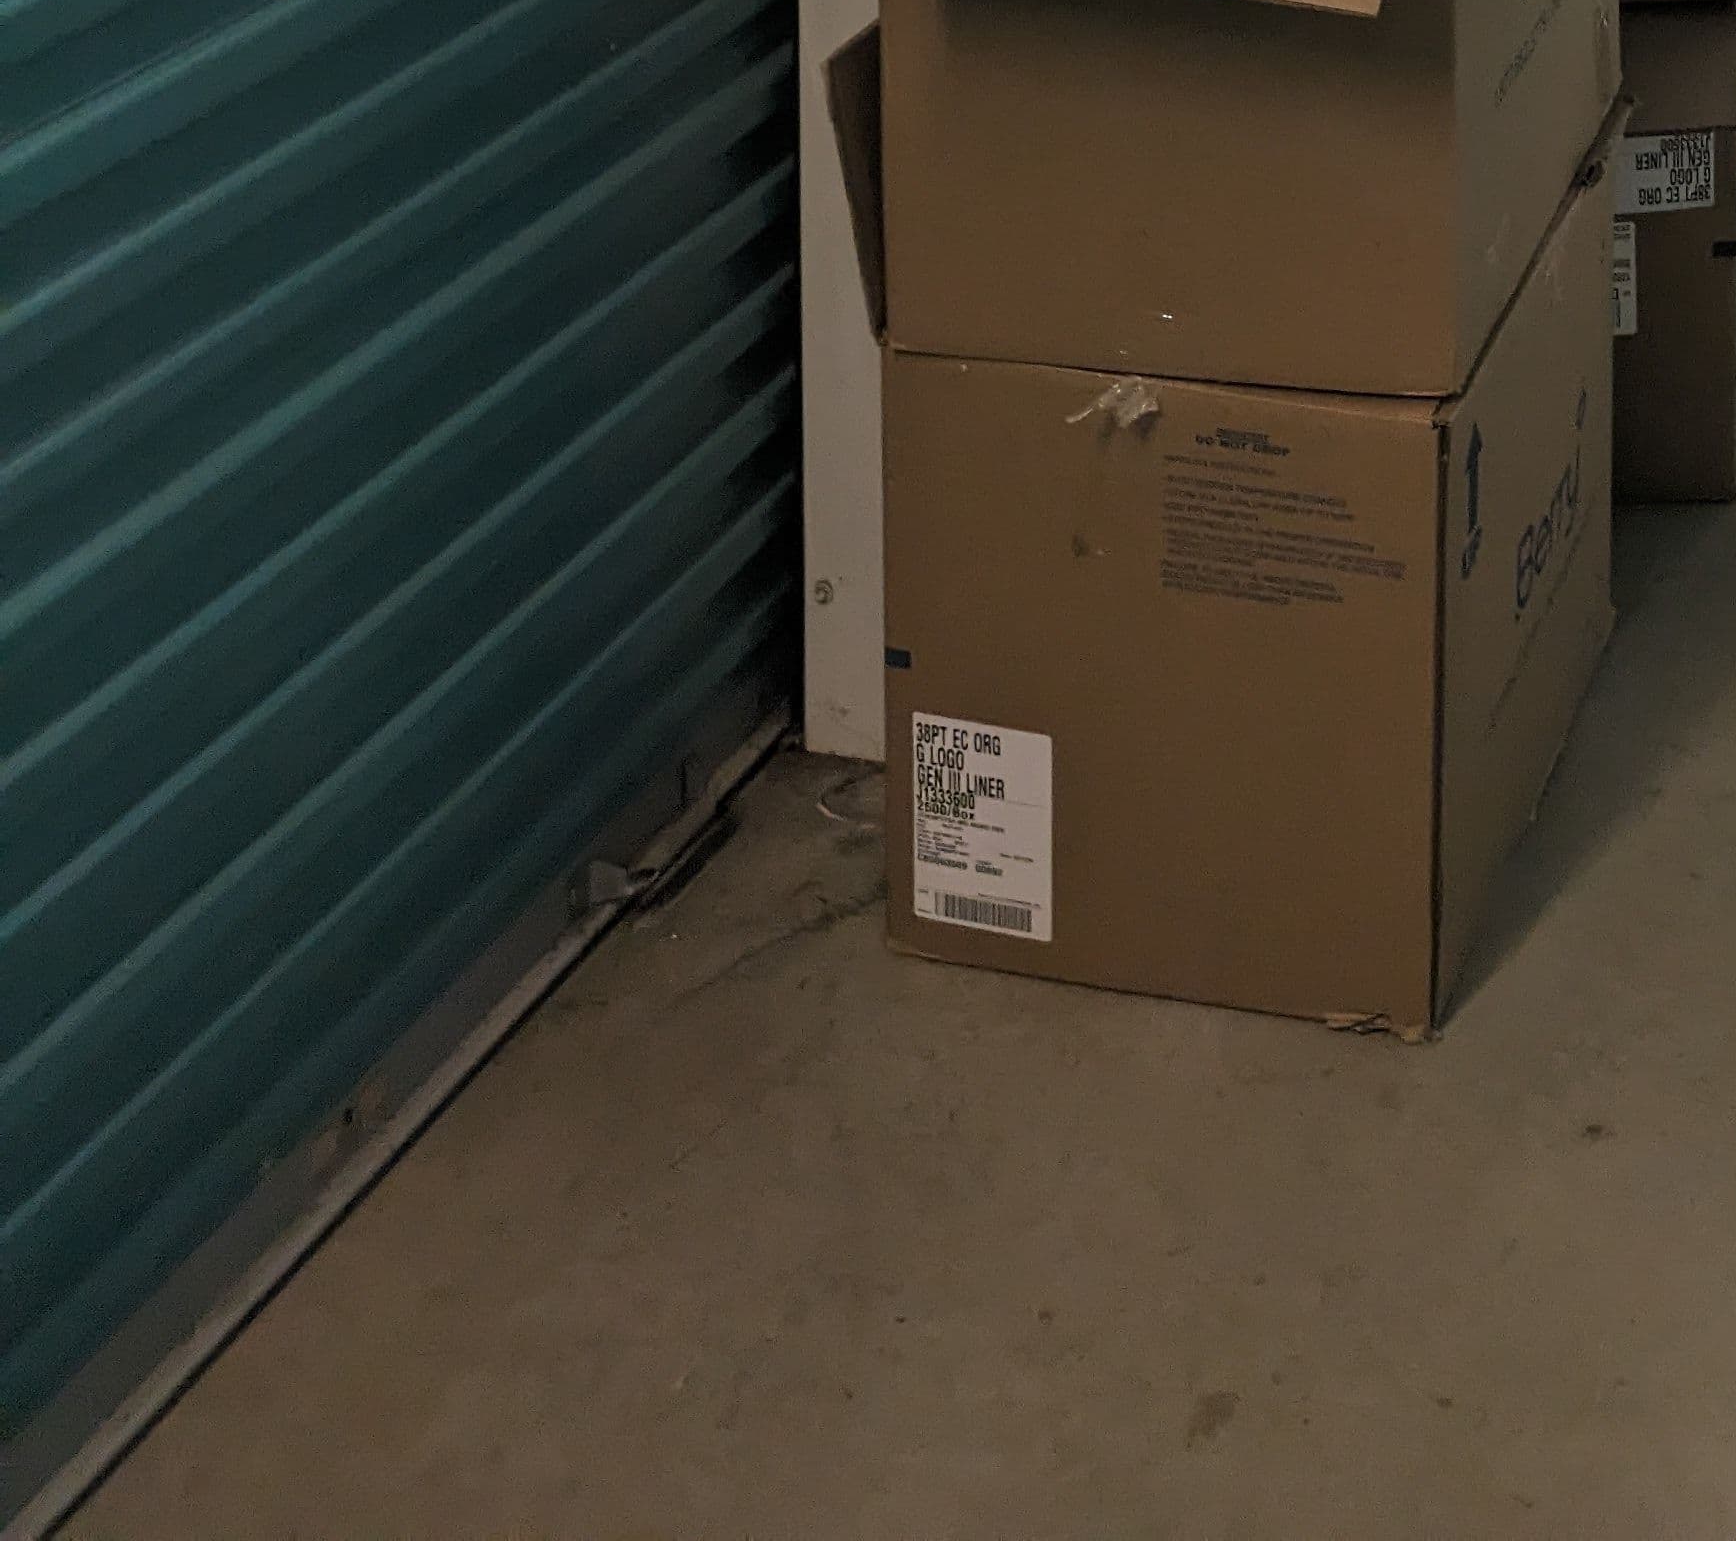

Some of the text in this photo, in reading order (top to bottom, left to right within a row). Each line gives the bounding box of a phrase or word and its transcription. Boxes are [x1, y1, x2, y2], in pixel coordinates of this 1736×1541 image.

[1635, 152, 1668, 171] LINER
[1669, 168, 1699, 185] LOGO
[1515, 443, 1581, 610] Berry
[916, 721, 1001, 756] 38PT EC ORG
[916, 743, 965, 771] G LOGO
[917, 763, 943, 788] GEN
[966, 772, 1005, 800] LINER
